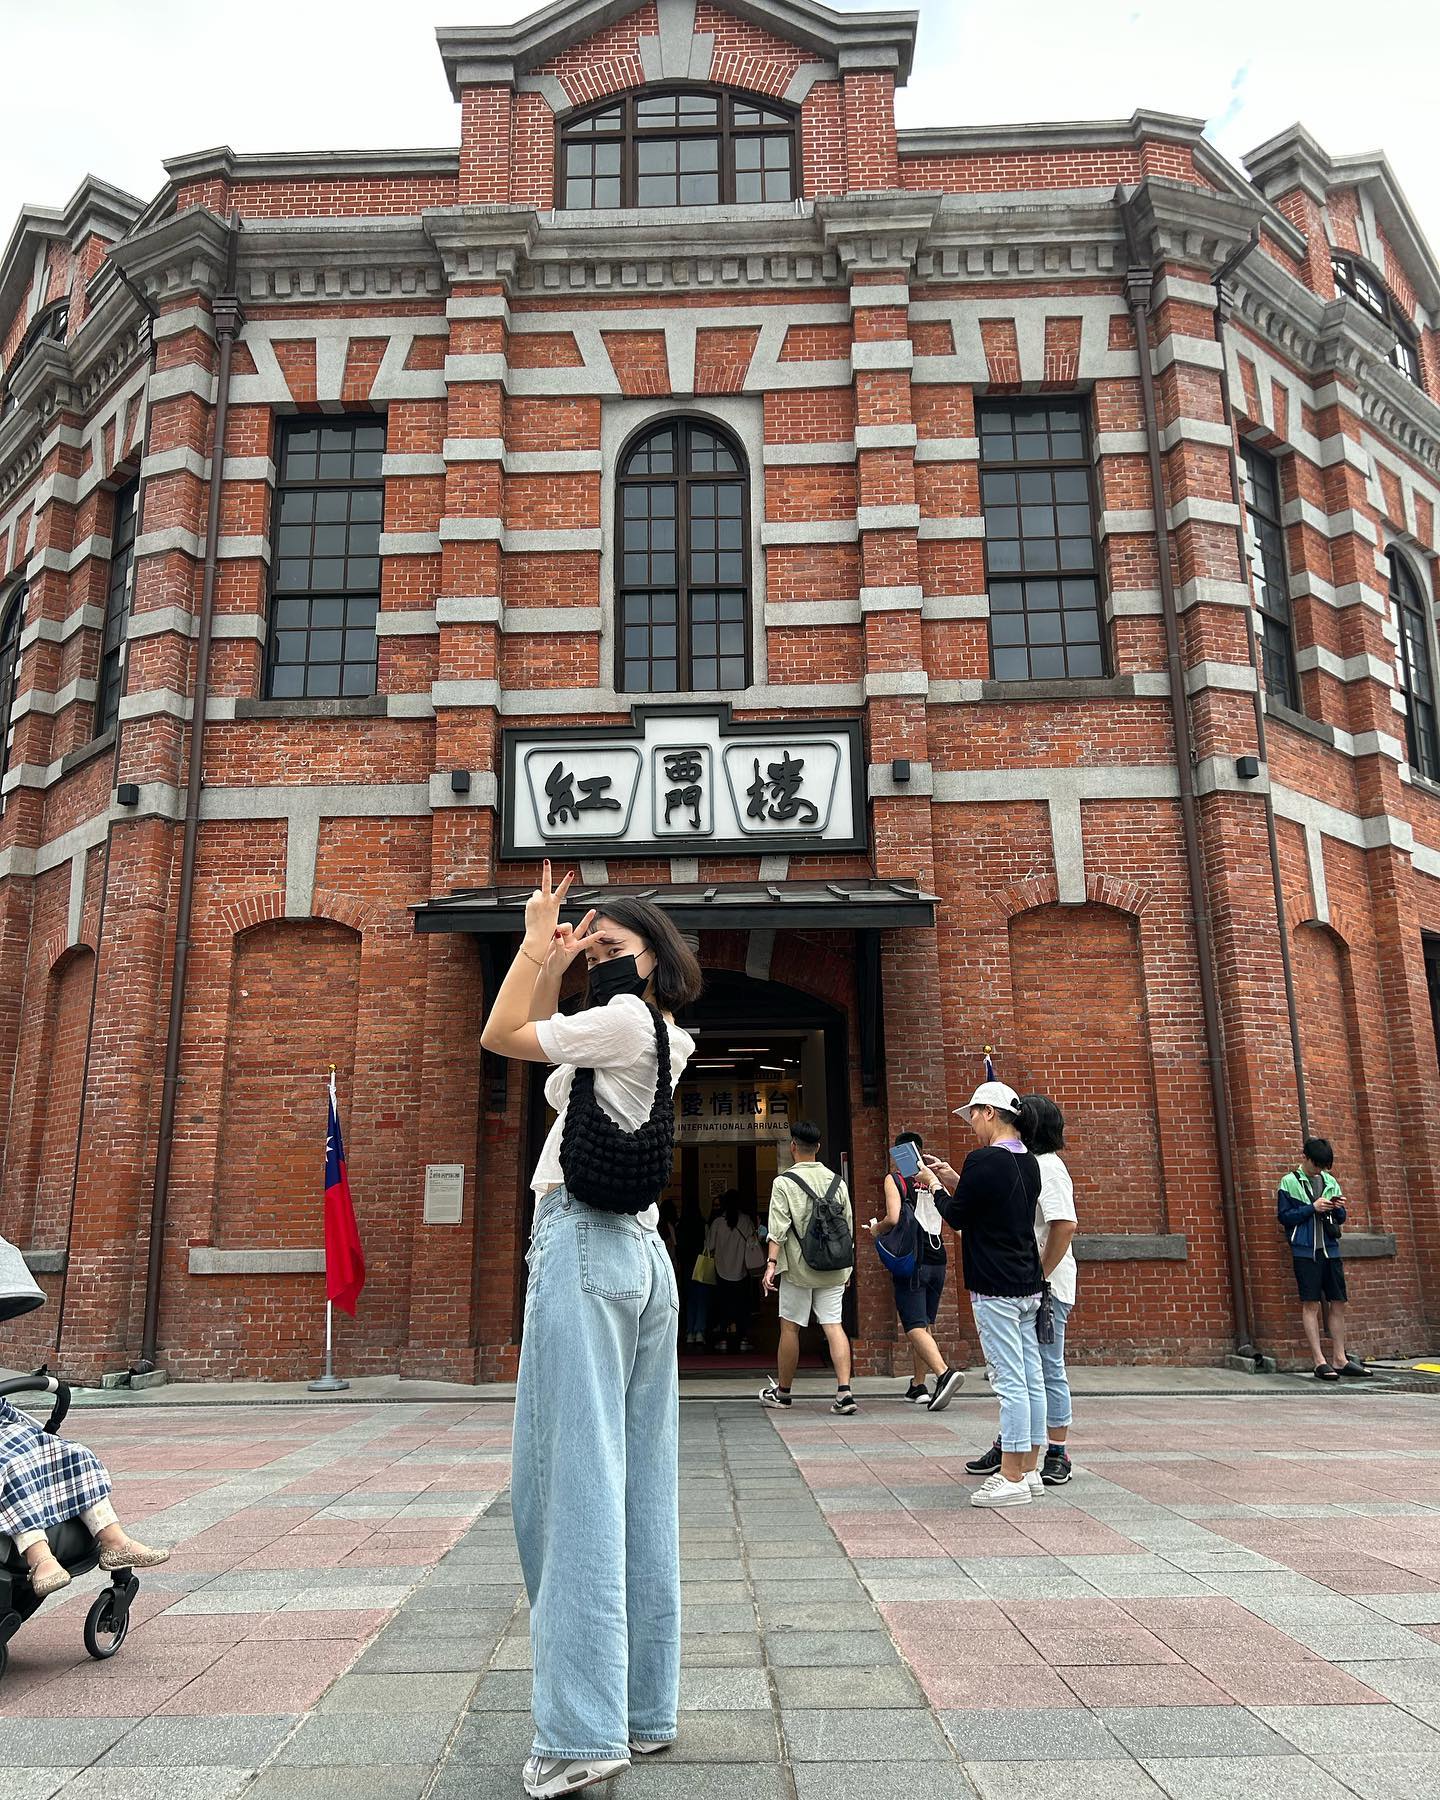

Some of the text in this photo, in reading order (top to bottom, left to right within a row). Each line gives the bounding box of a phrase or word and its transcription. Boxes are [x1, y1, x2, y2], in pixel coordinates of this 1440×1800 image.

[682, 1091, 789, 1116] 愛情抵台
[678, 1122, 789, 1131] INTERNATIONAL ARRIVALS
